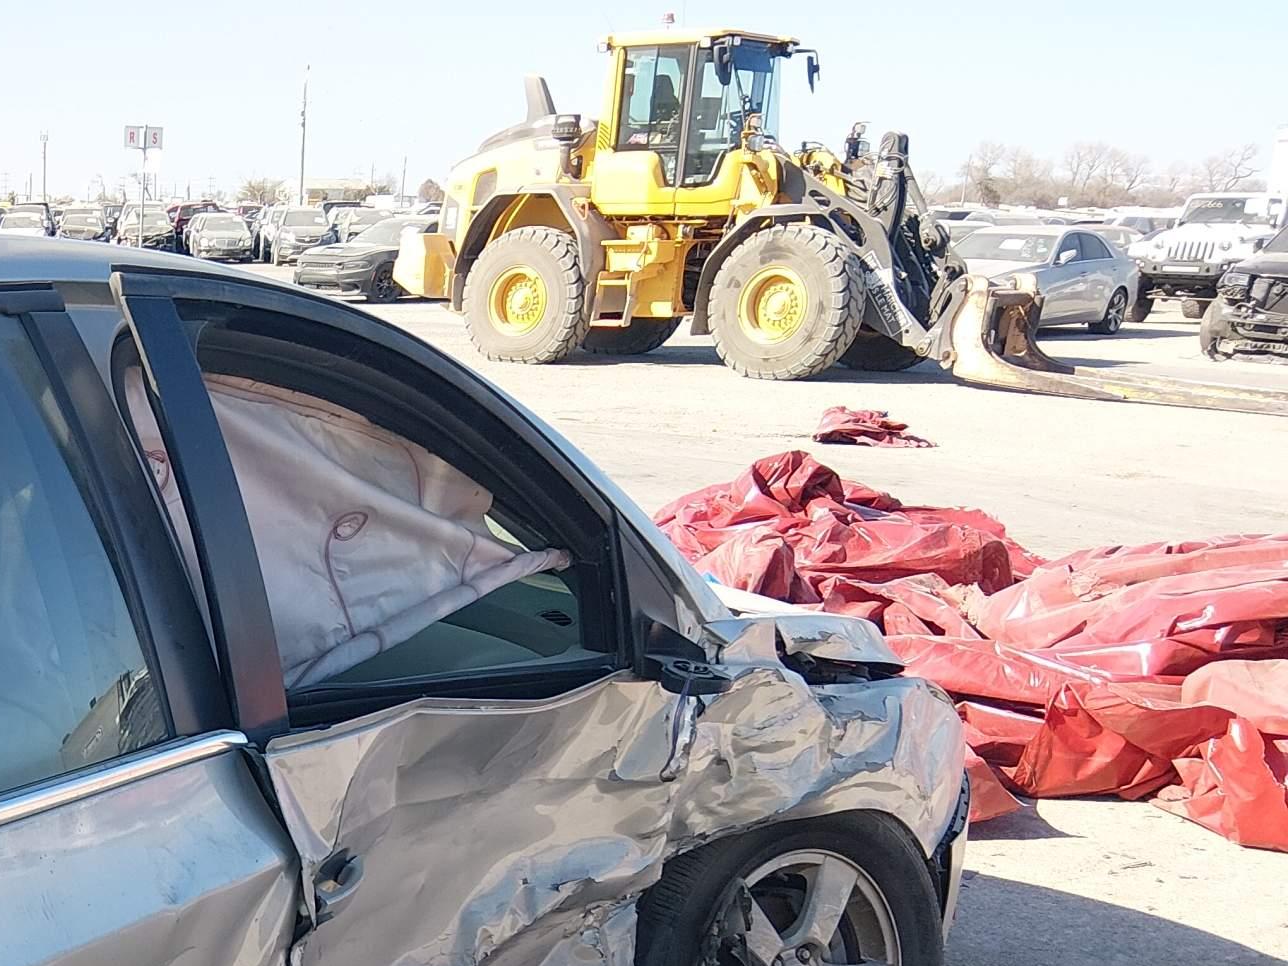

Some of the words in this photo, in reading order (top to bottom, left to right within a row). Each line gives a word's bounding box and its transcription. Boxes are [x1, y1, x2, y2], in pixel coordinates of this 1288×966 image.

[129, 131, 135, 144] R
[152, 132, 158, 144] S
[880, 304, 896, 324] MAT
